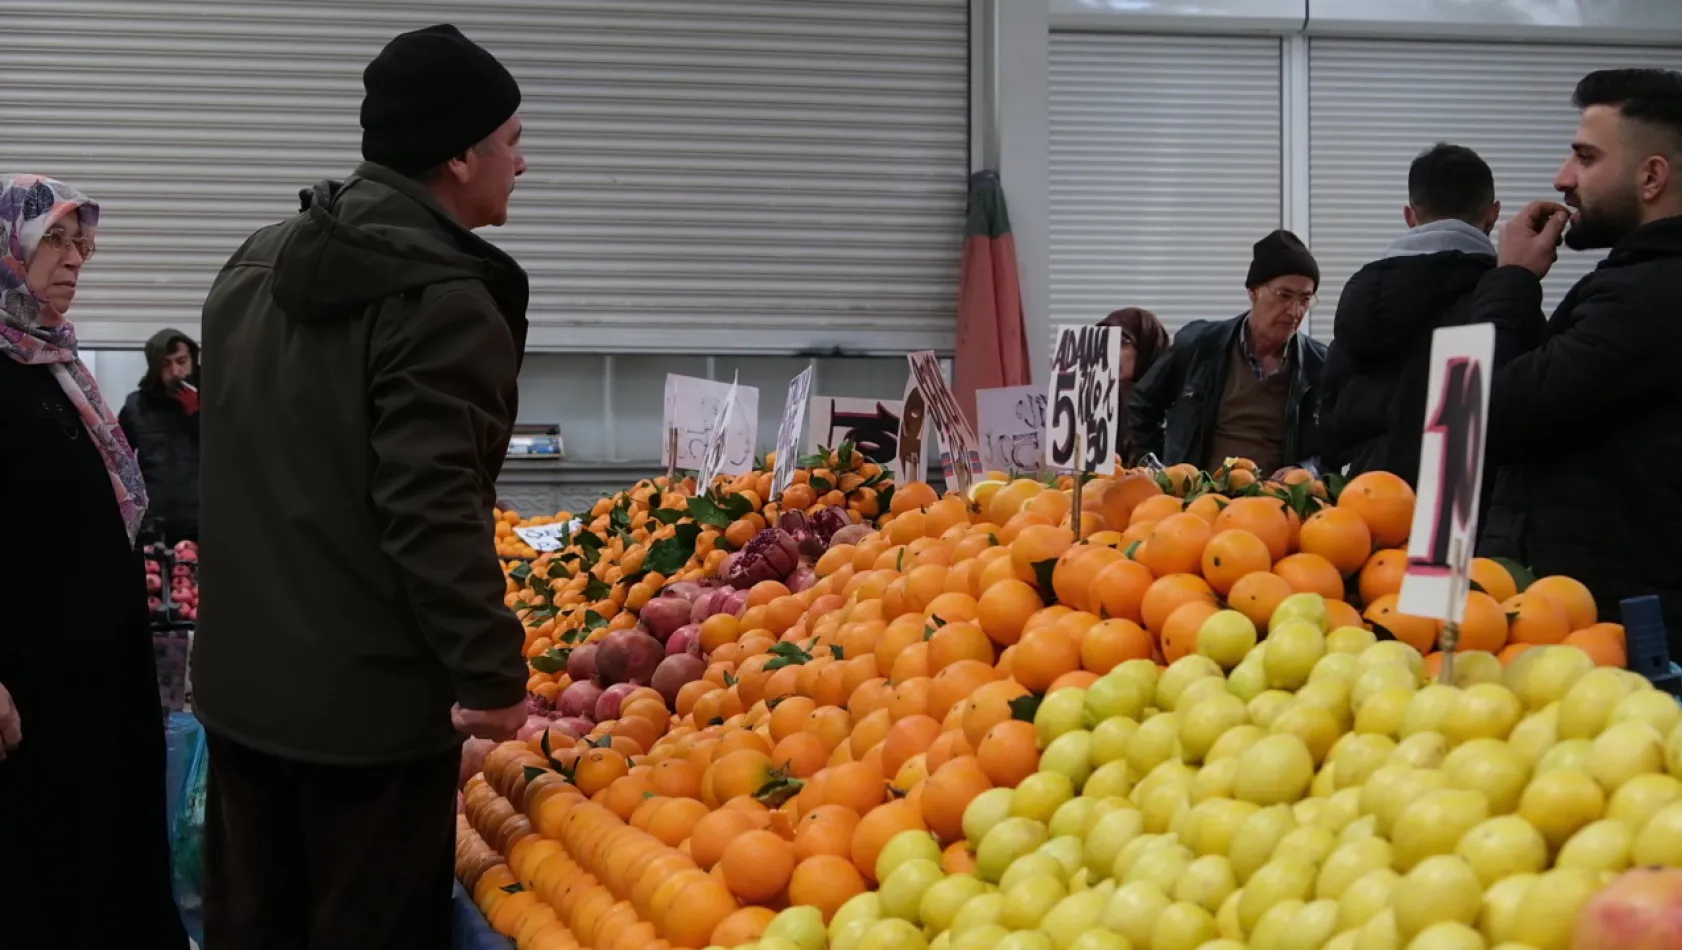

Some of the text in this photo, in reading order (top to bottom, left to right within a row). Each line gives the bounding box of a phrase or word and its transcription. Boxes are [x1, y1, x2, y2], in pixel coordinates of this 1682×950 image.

[1052, 325, 1109, 373] ADANA
[1052, 371, 1077, 466] 5
[1085, 416, 1108, 474] 50
[1406, 356, 1483, 576] 10
